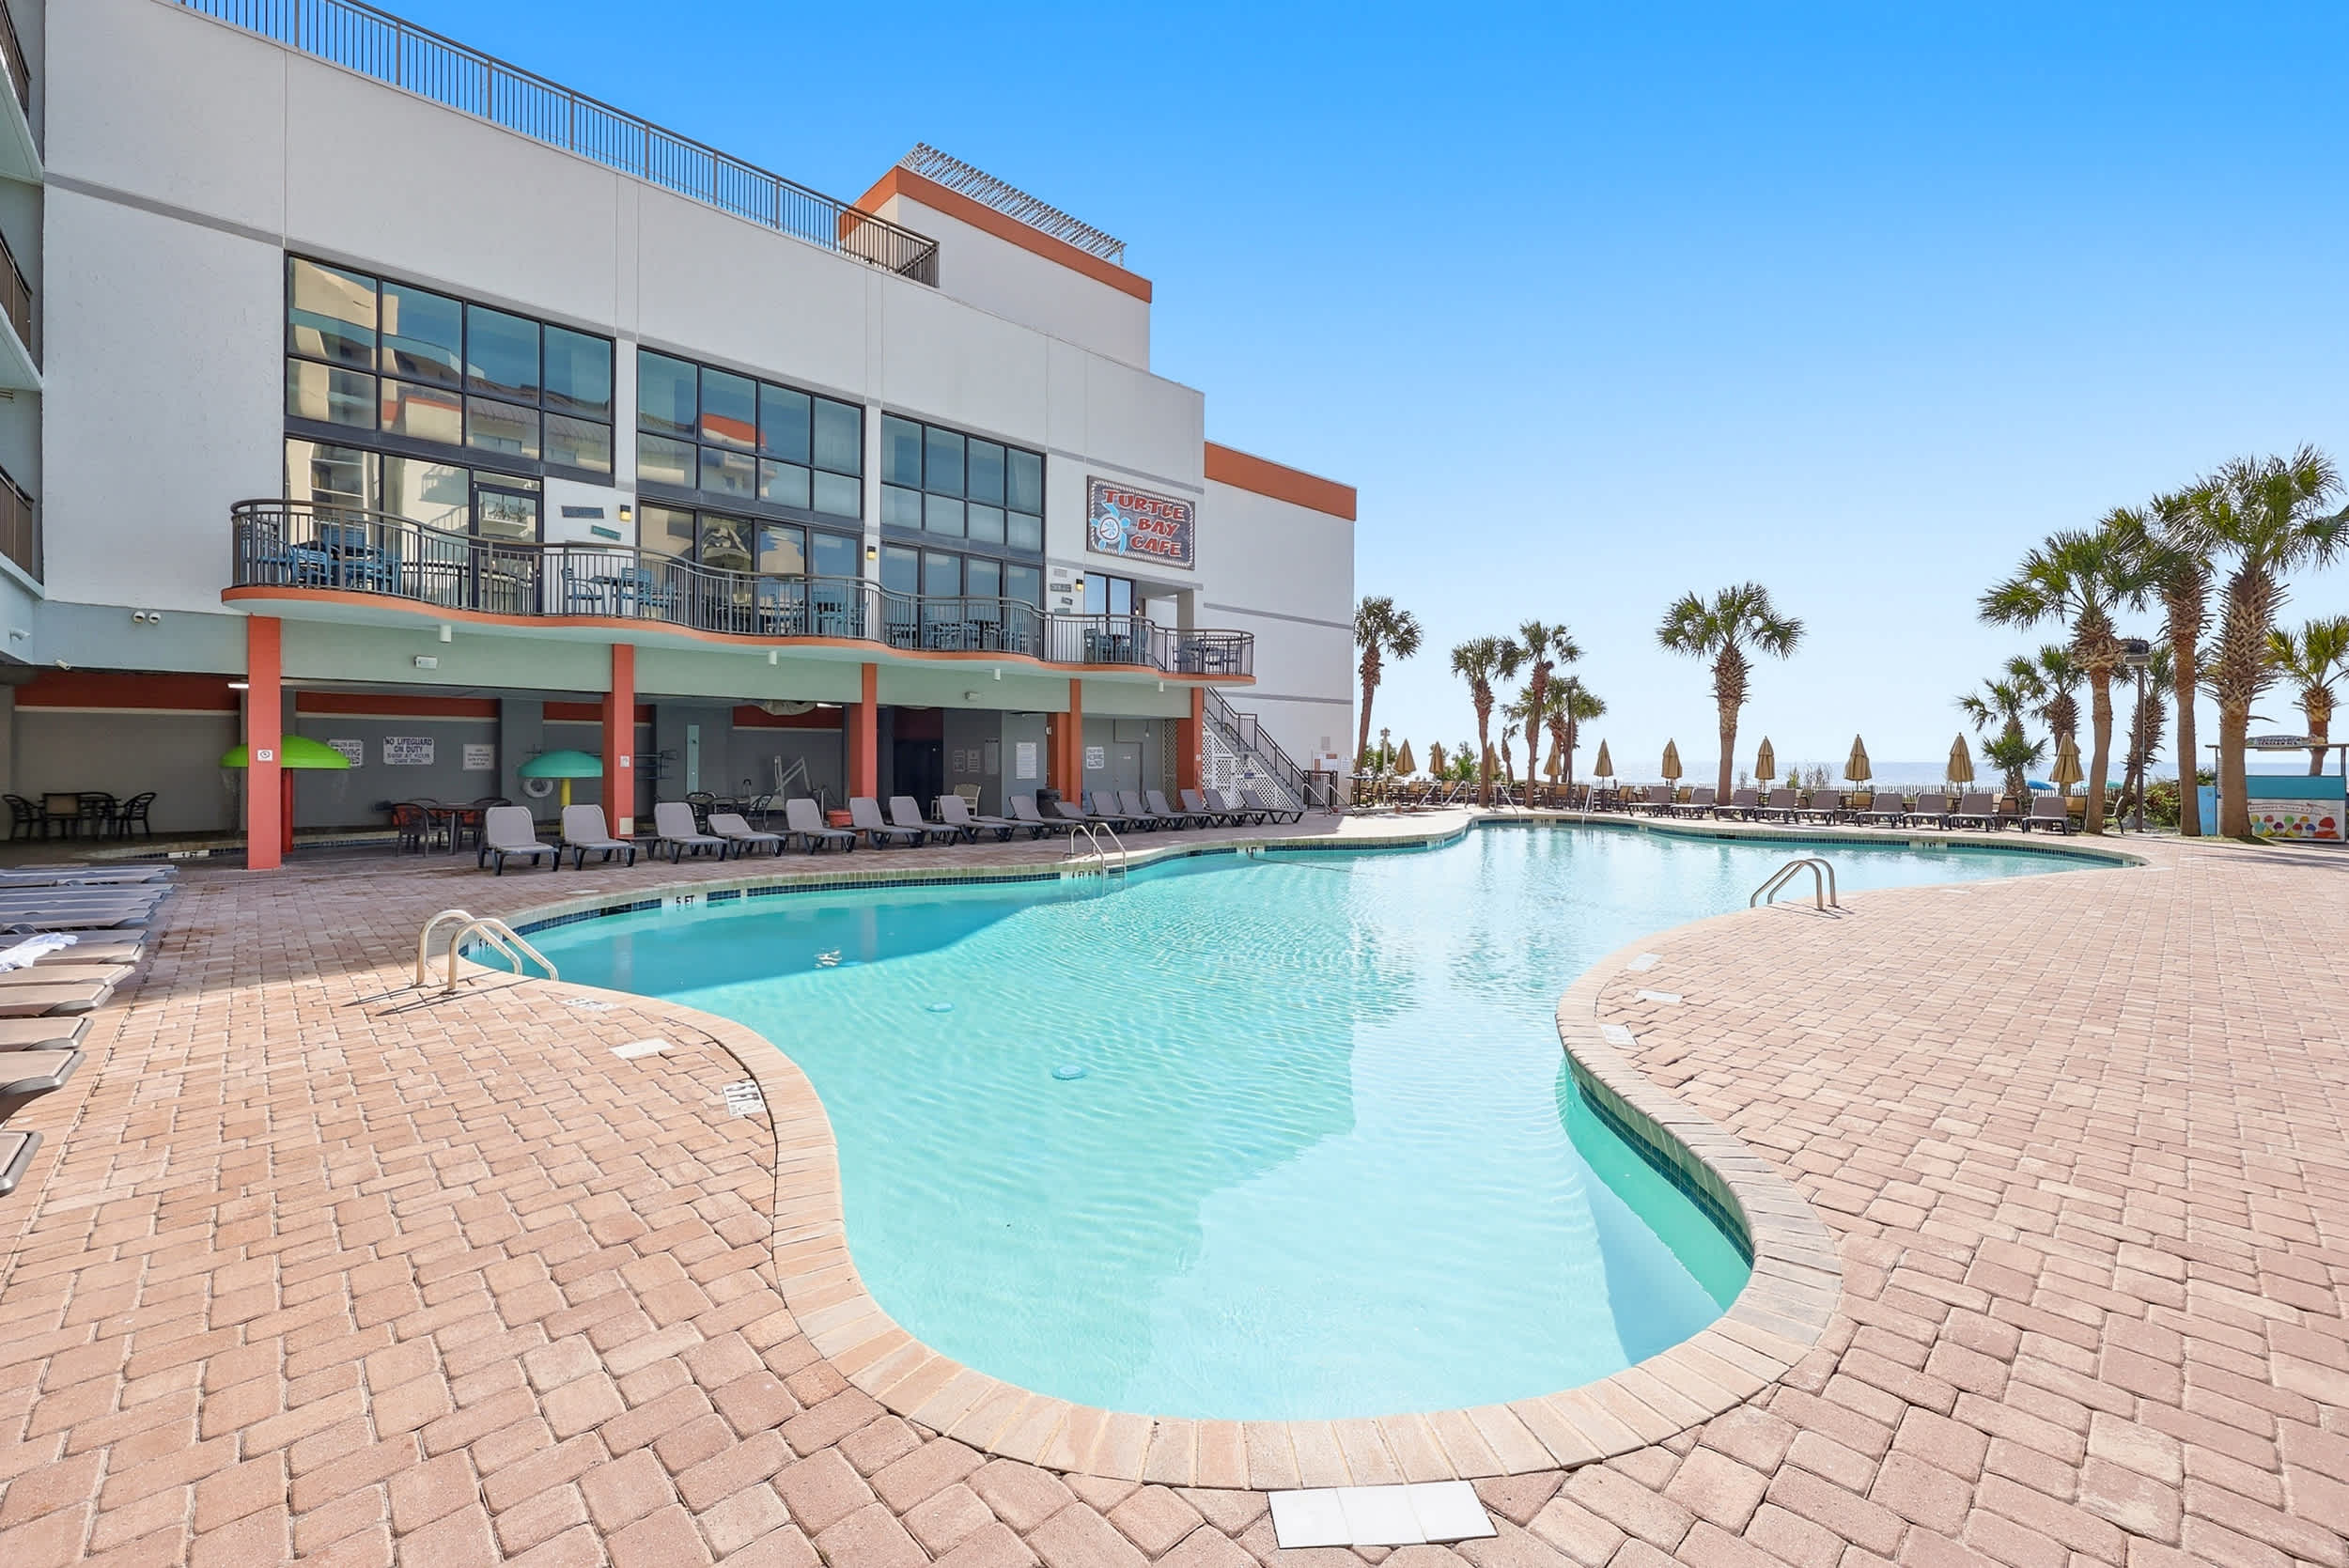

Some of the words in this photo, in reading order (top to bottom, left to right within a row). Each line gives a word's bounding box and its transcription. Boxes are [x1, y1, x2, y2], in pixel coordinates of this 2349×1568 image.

[1103, 489, 1185, 520] TURTLE
[1137, 518, 1180, 538] BAY
[1130, 536, 1181, 557] CAFE
[397, 737, 432, 746] LIFEGUARD
[685, 894, 694, 905] FT
